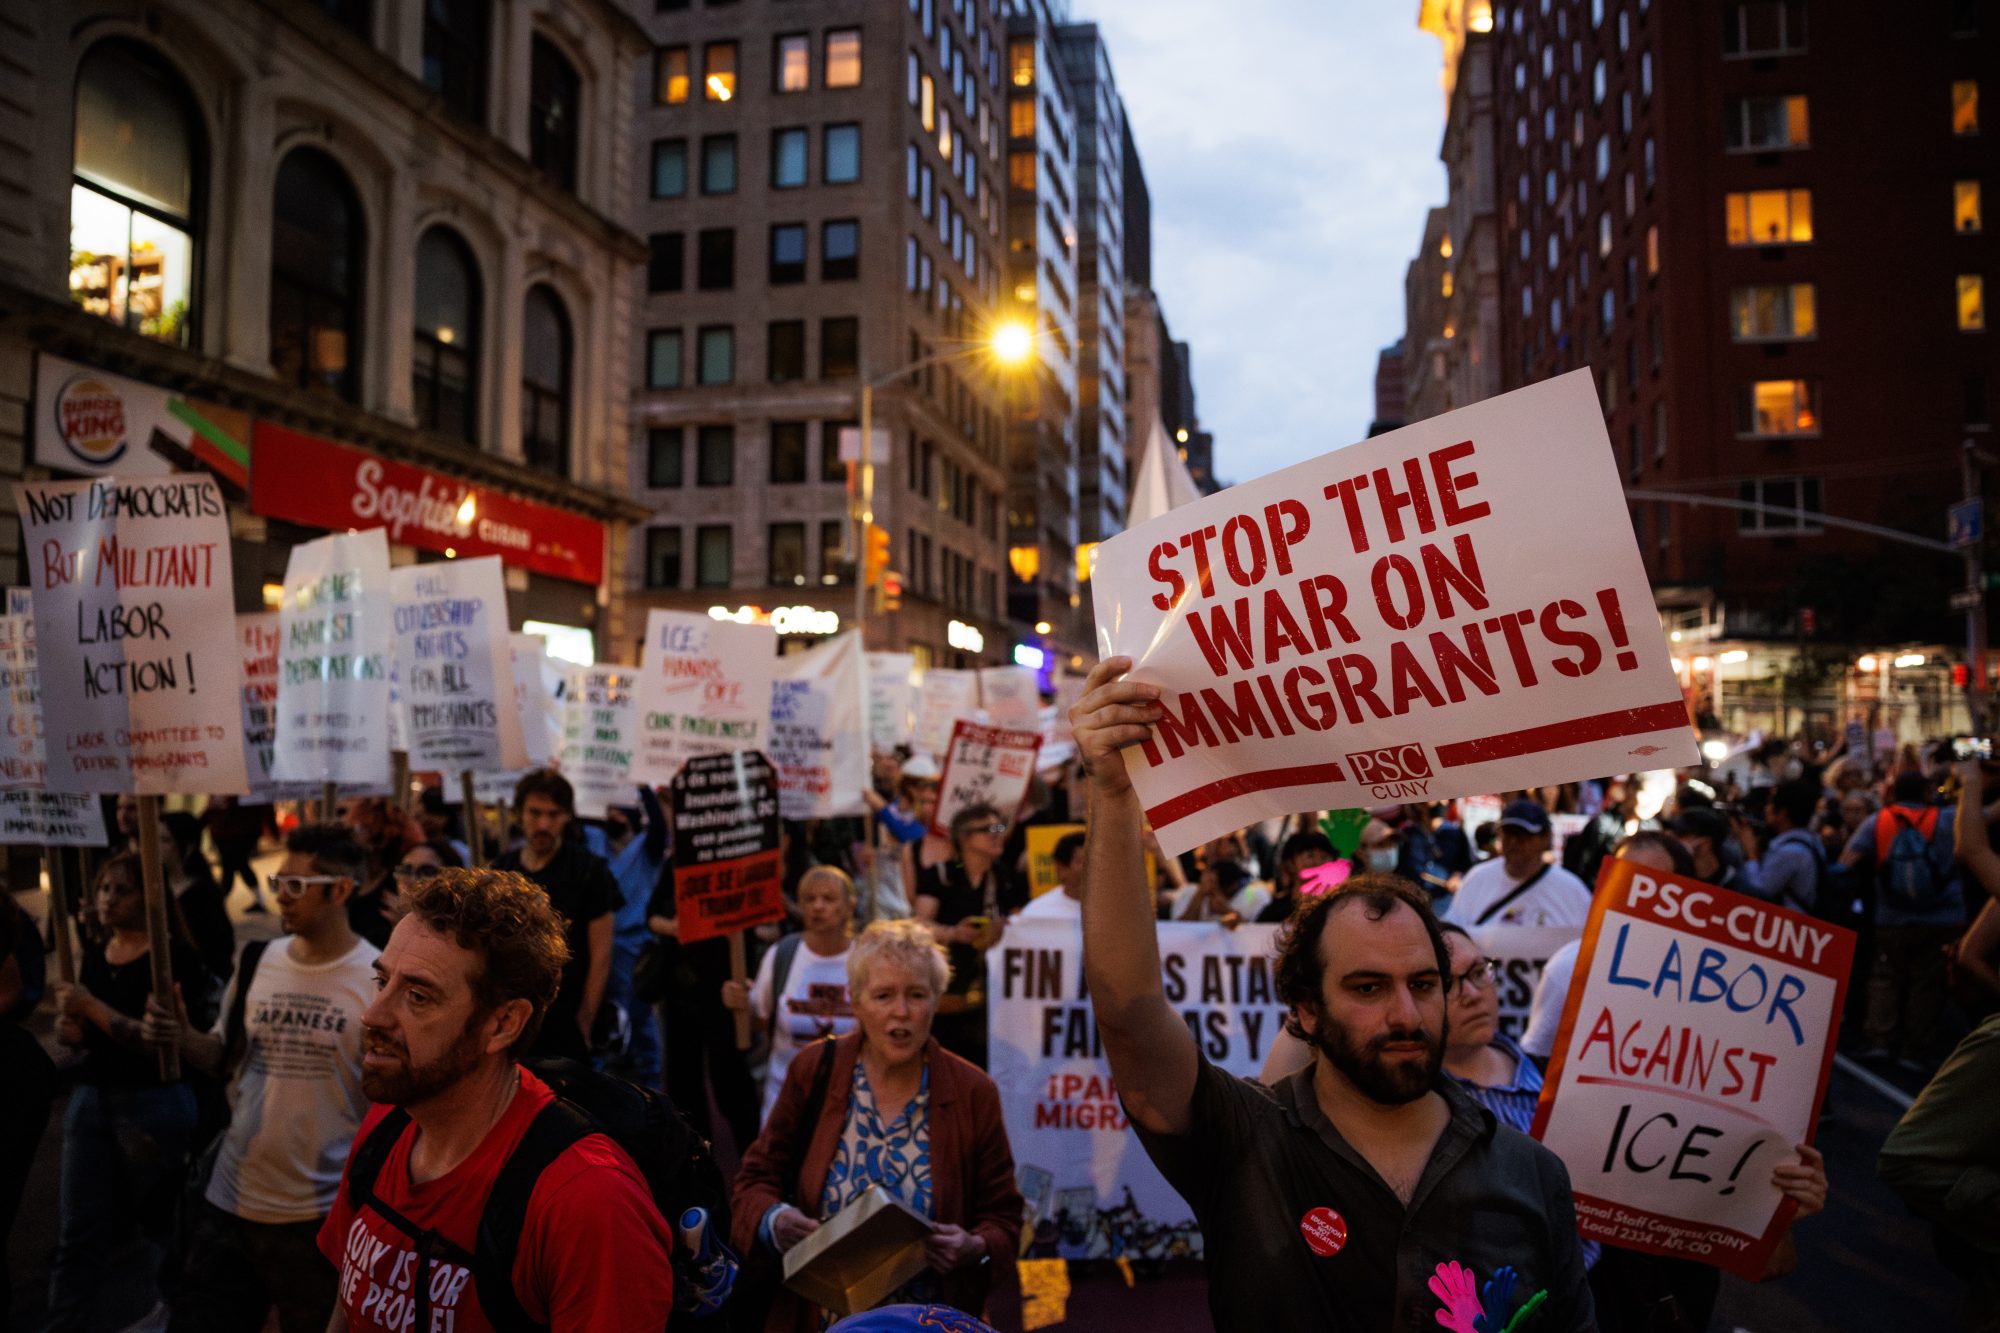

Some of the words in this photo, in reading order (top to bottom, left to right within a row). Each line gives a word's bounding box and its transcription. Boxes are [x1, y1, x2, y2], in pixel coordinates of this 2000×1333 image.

[64, 413, 124, 442] KING
[25, 489, 76, 526] NOT
[89, 481, 221, 520] DEMOCRATS
[1147, 499, 1311, 612] STOP
[1324, 440, 1491, 553] THE
[96, 532, 217, 590] MILITANT
[78, 600, 170, 644] LABOR
[1186, 574, 1361, 677] WAR
[1371, 533, 1490, 631] ON
[1348, 745, 1428, 784] PSC
[1371, 779, 1428, 800] CUNY
[1626, 873, 1834, 965] PSC-CUNY
[1004, 948, 1062, 999] FIN
[1607, 922, 1806, 1046] LABOR
[1578, 1006, 1777, 1103] AGAINST
[1601, 1104, 1765, 1196] ICE!
[1582, 1217, 1618, 1236] Local
[1620, 1226, 1651, 1245] 2334
[1662, 1237, 1713, 1255] AFL-CIO
[1613, 1209, 1648, 1229] Staff
[388, 1249, 419, 1292] IS
[429, 1258, 471, 1308] OR
